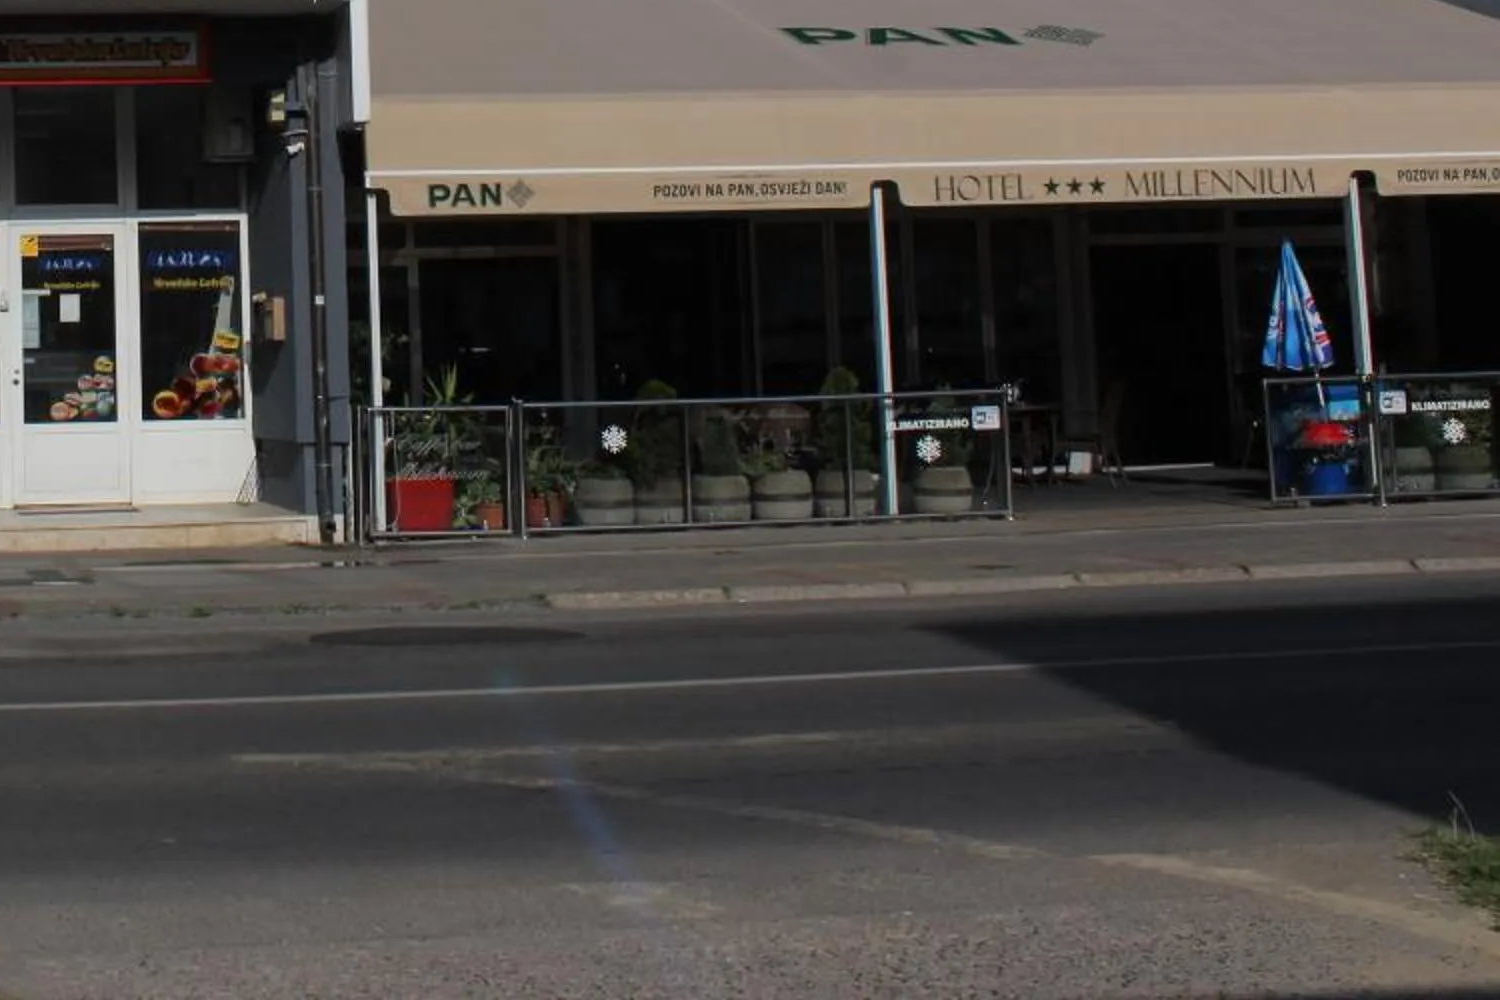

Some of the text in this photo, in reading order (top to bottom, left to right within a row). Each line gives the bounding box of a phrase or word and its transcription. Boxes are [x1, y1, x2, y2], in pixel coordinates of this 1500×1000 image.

[780, 26, 1023, 47] PAN
[934, 167, 1317, 201] HOTEL MILLENNIUM
[1397, 168, 1439, 182] POZOVI
[1443, 168, 1459, 181] NA
[427, 182, 502, 208] PAN
[653, 183, 701, 198] POZOVI
[706, 183, 724, 197] NA
